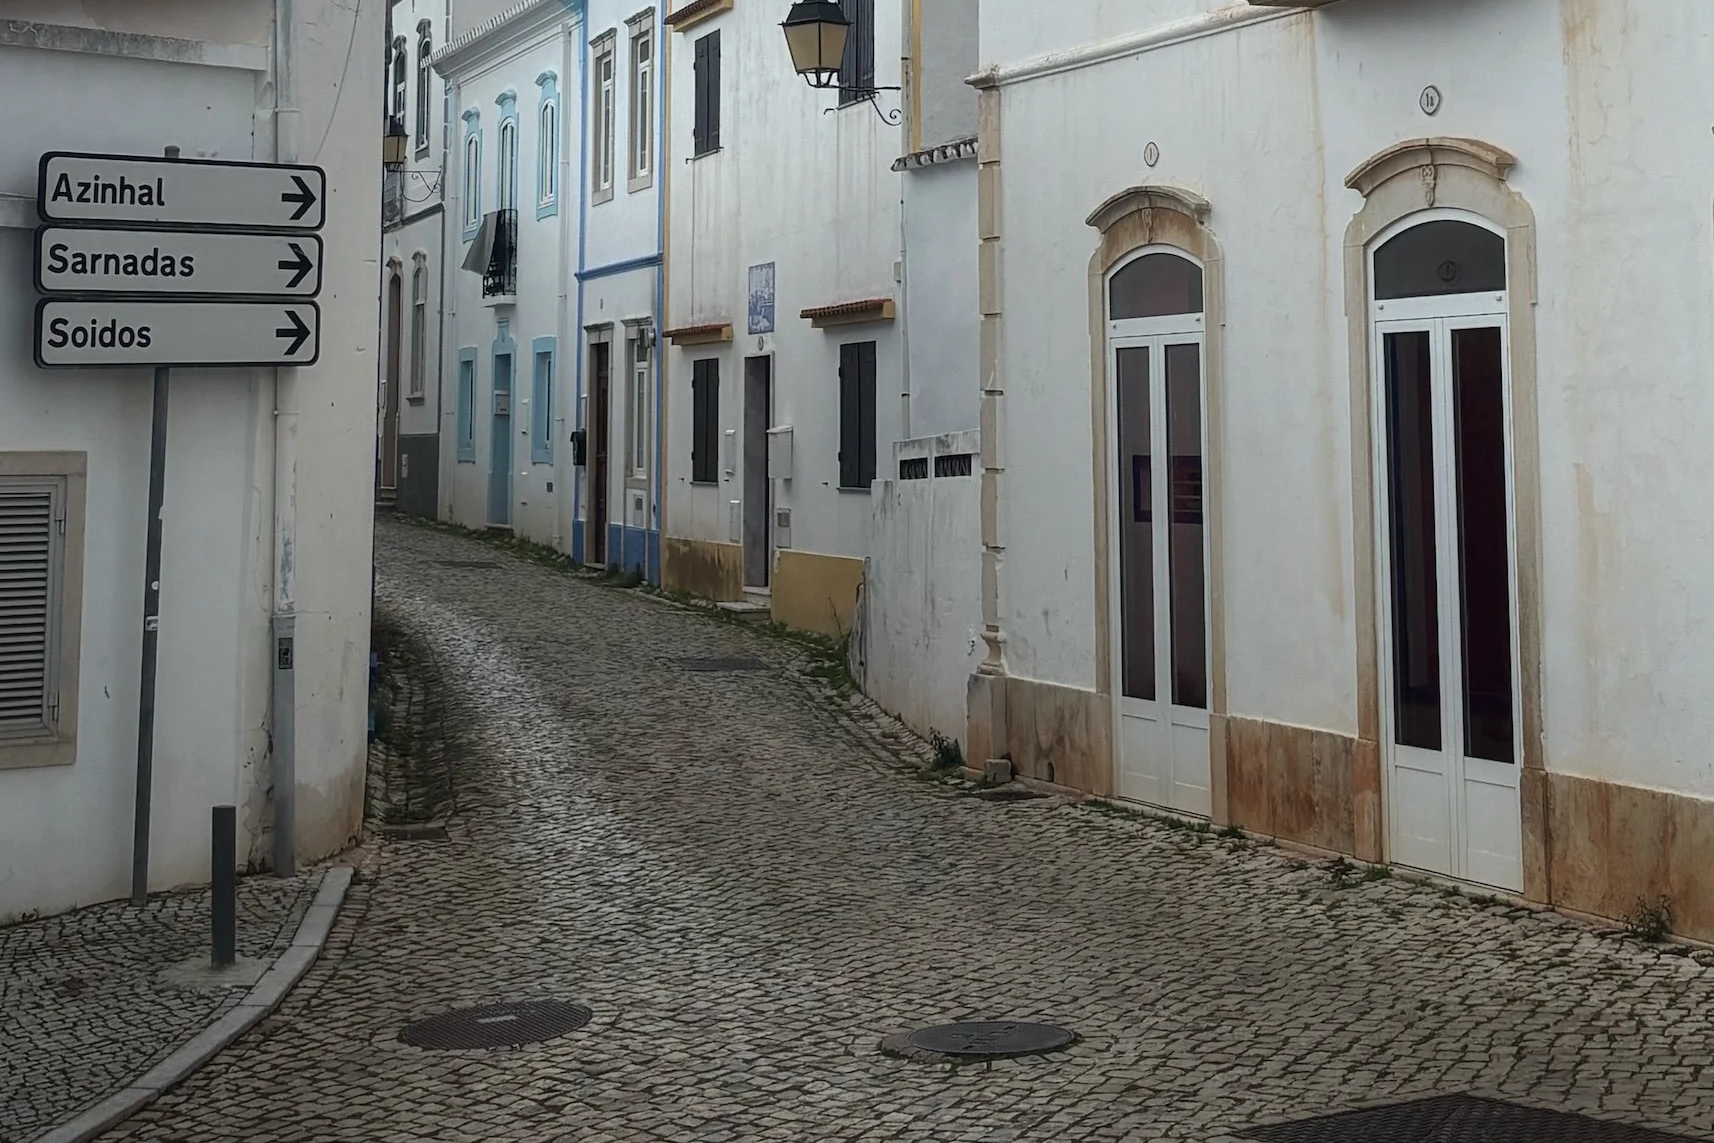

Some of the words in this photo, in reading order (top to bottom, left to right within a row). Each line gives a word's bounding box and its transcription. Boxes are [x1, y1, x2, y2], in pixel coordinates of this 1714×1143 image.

[51, 173, 165, 206] Azinhal
[47, 243, 194, 277] Sarnadas
[47, 317, 151, 348] Soidos
